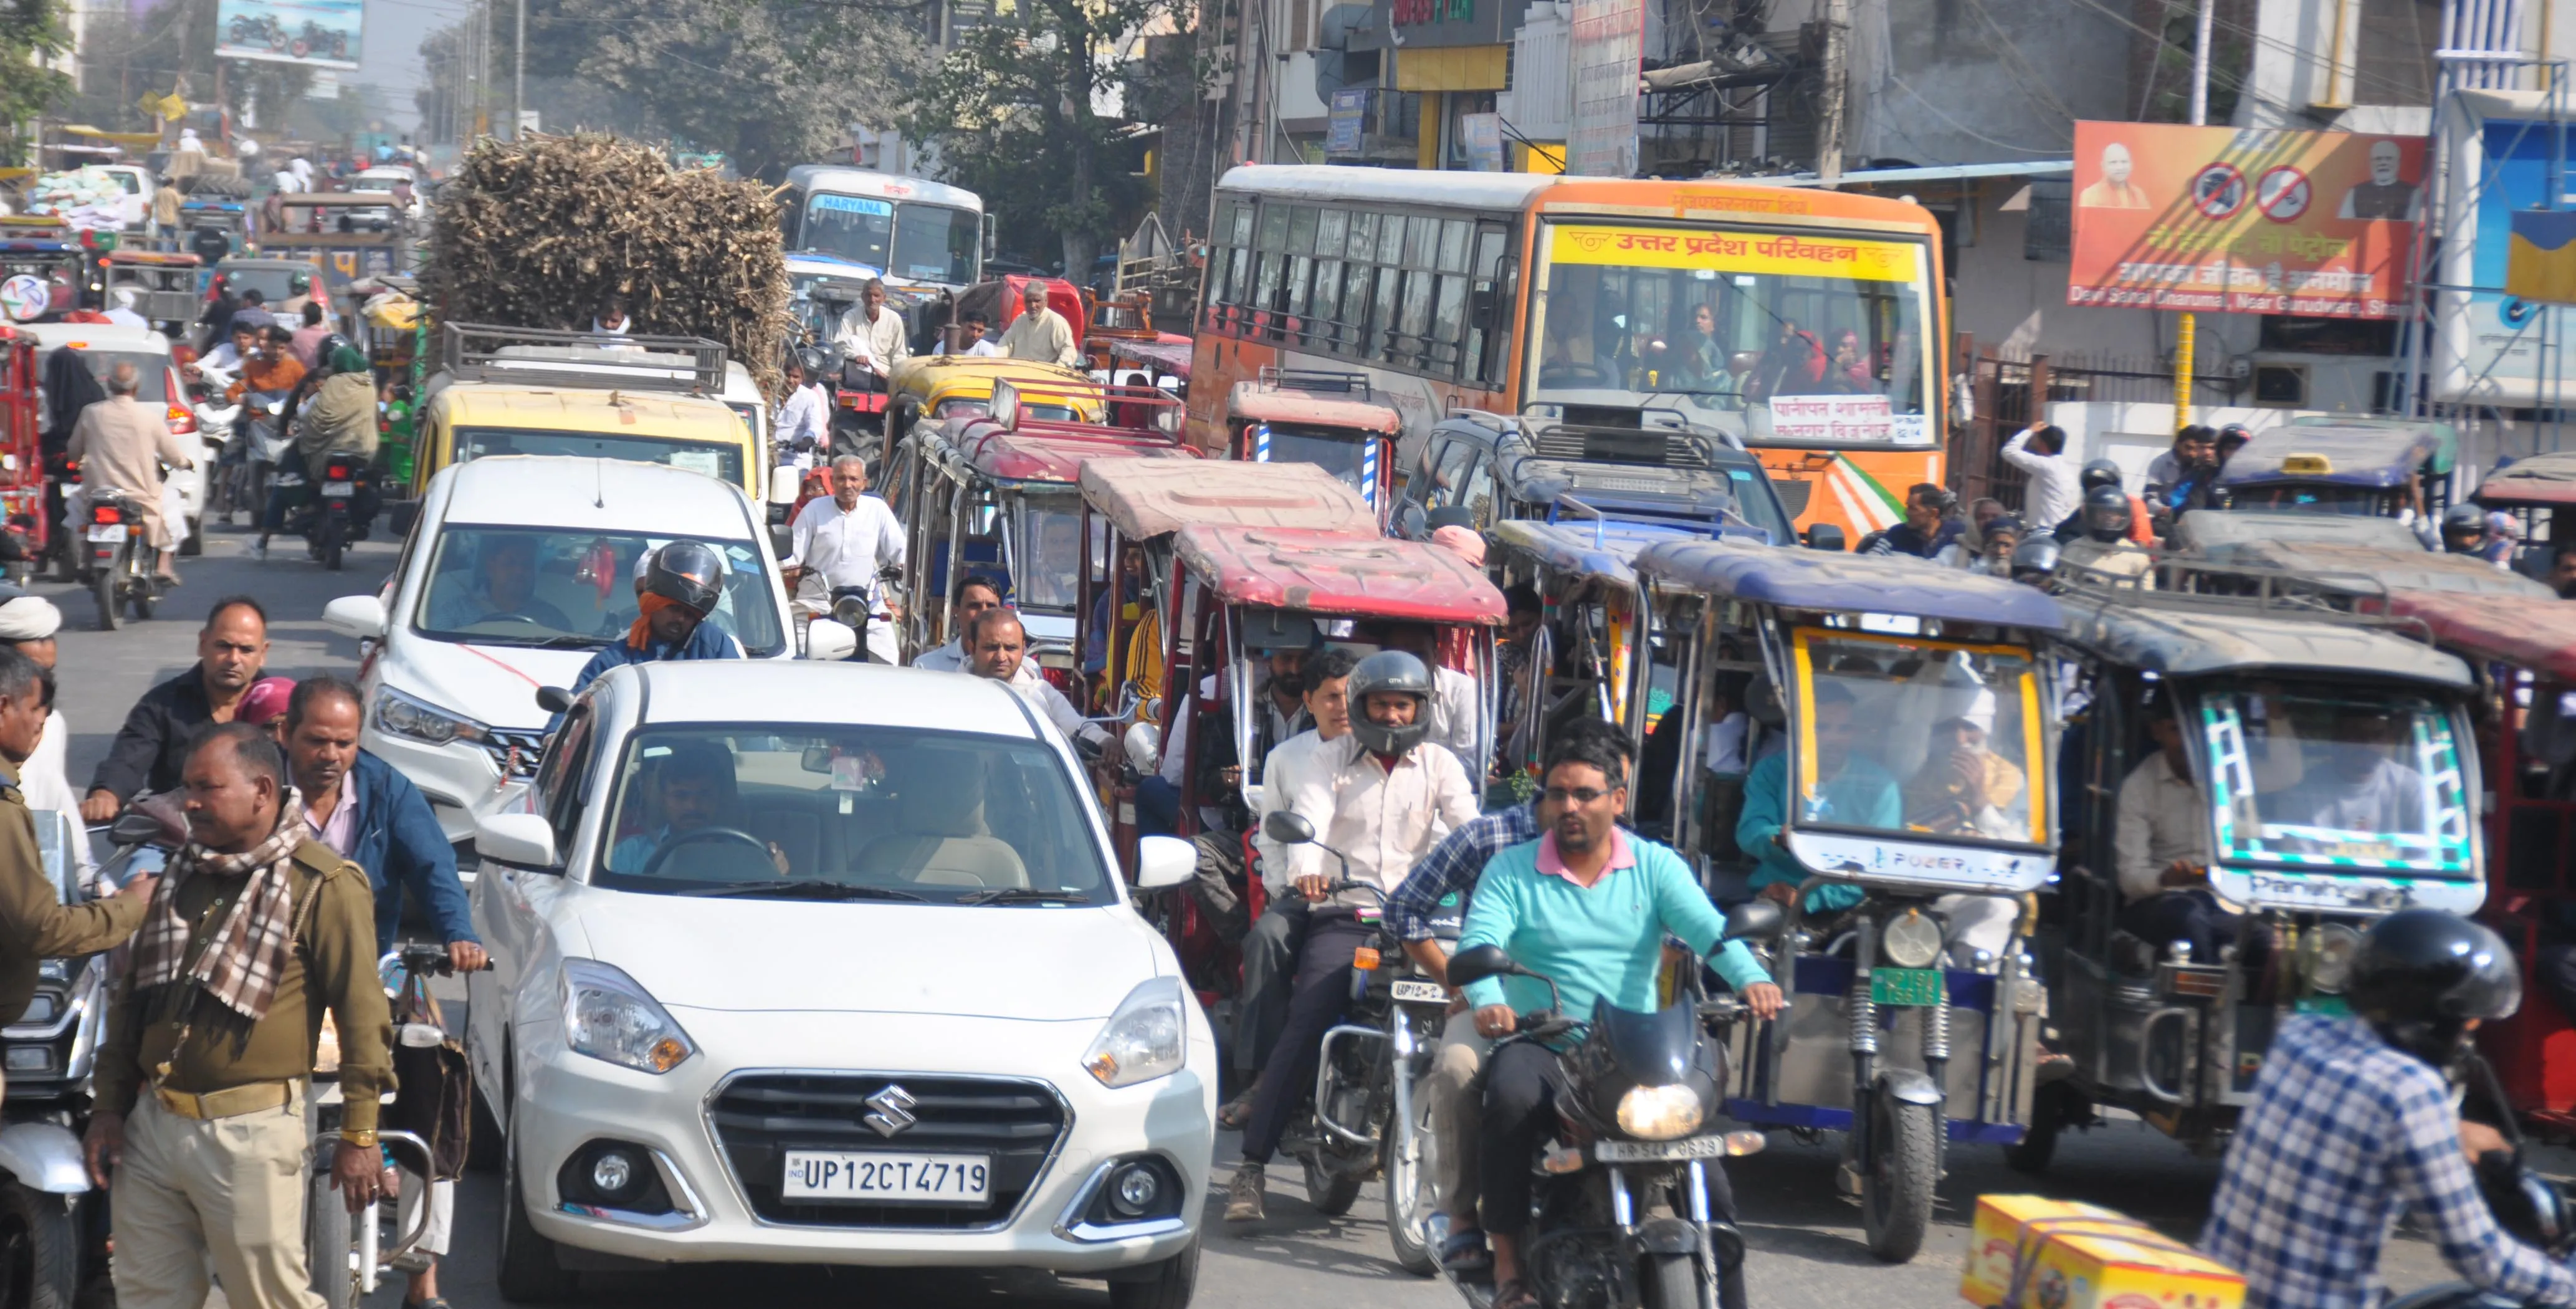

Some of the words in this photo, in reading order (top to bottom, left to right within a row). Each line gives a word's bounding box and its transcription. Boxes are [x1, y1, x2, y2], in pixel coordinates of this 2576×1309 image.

[824, 195, 882, 215] HARYANA
[1616, 234, 1679, 252] उत्तर
[1684, 233, 1748, 256] प्रदेश
[1755, 236, 1859, 262] परिवहन
[2236, 292, 2273, 310] Near
[804, 1159, 986, 1193] UP12CT4719
